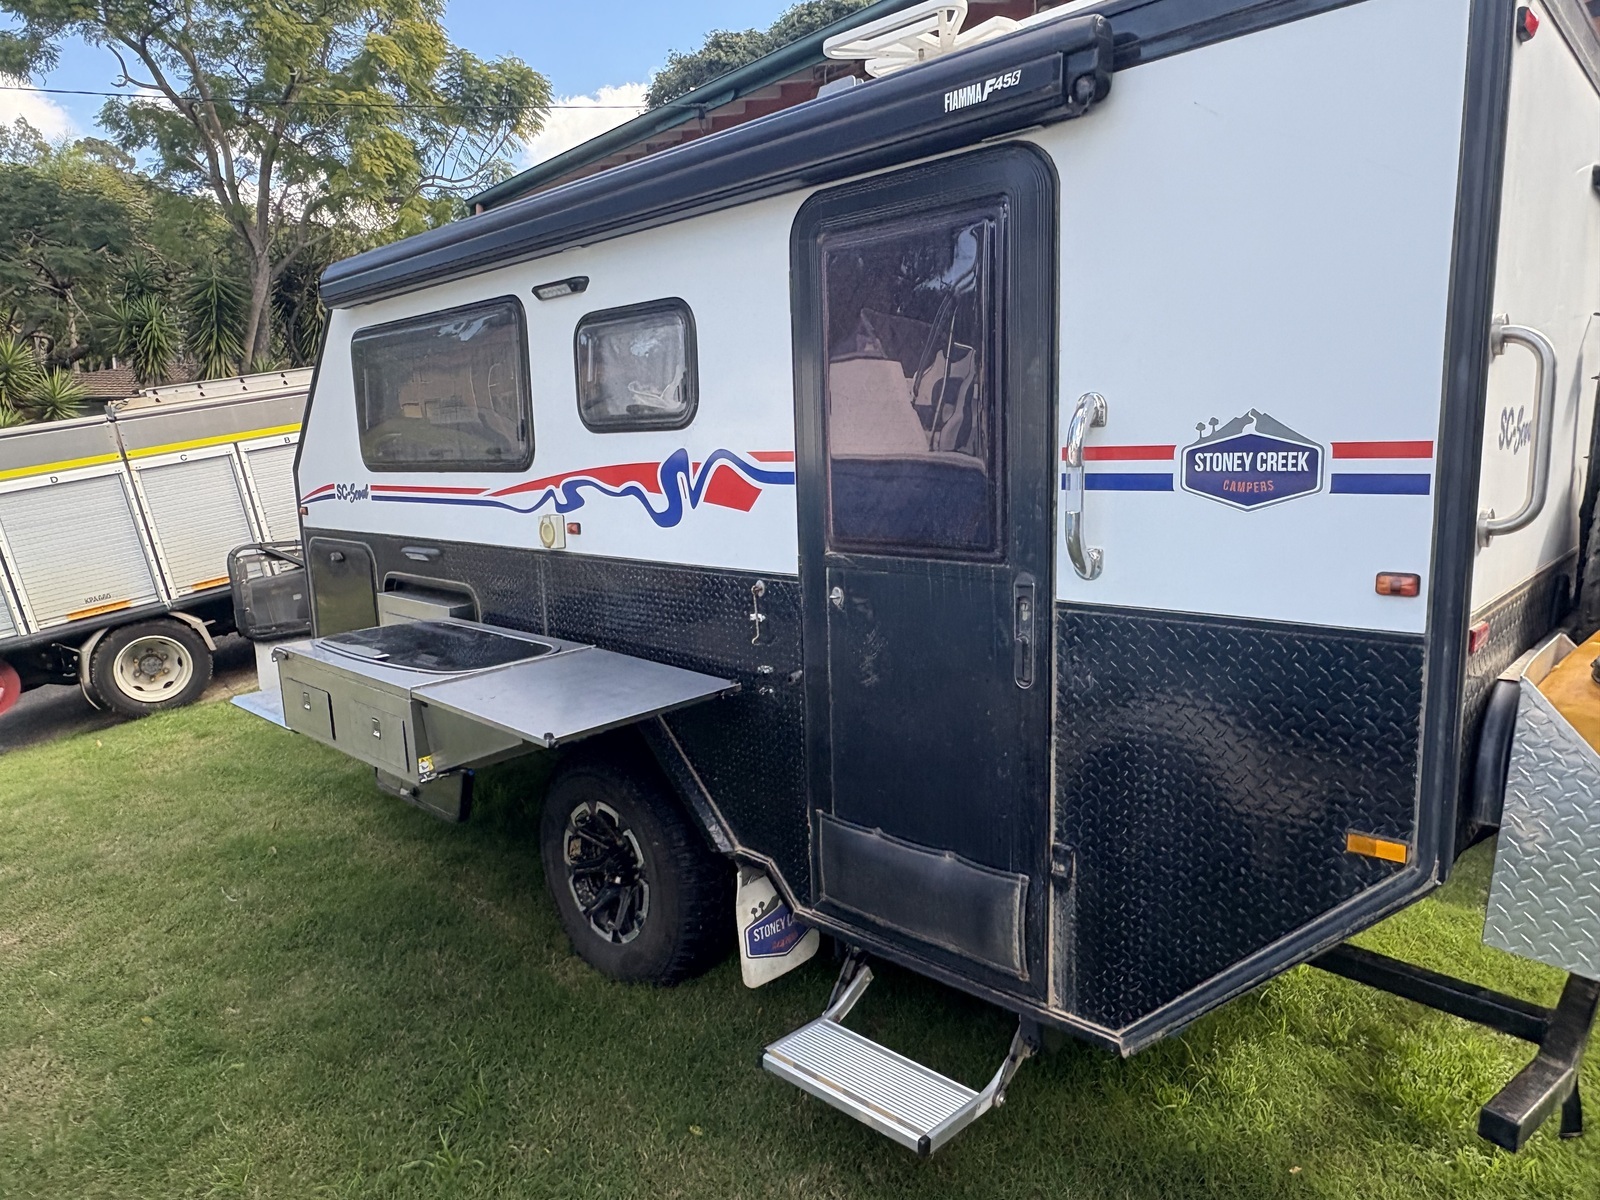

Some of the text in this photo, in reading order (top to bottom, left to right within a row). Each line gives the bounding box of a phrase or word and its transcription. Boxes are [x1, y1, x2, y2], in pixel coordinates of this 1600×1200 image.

[944, 82, 982, 113] FIAMMA
[180, 454, 188, 462] C
[1194, 451, 1310, 472] STONEY CREEK
[50, 476, 59, 484] D
[1223, 479, 1275, 493] CAMPERS
[753, 918, 786, 942] STONEY
